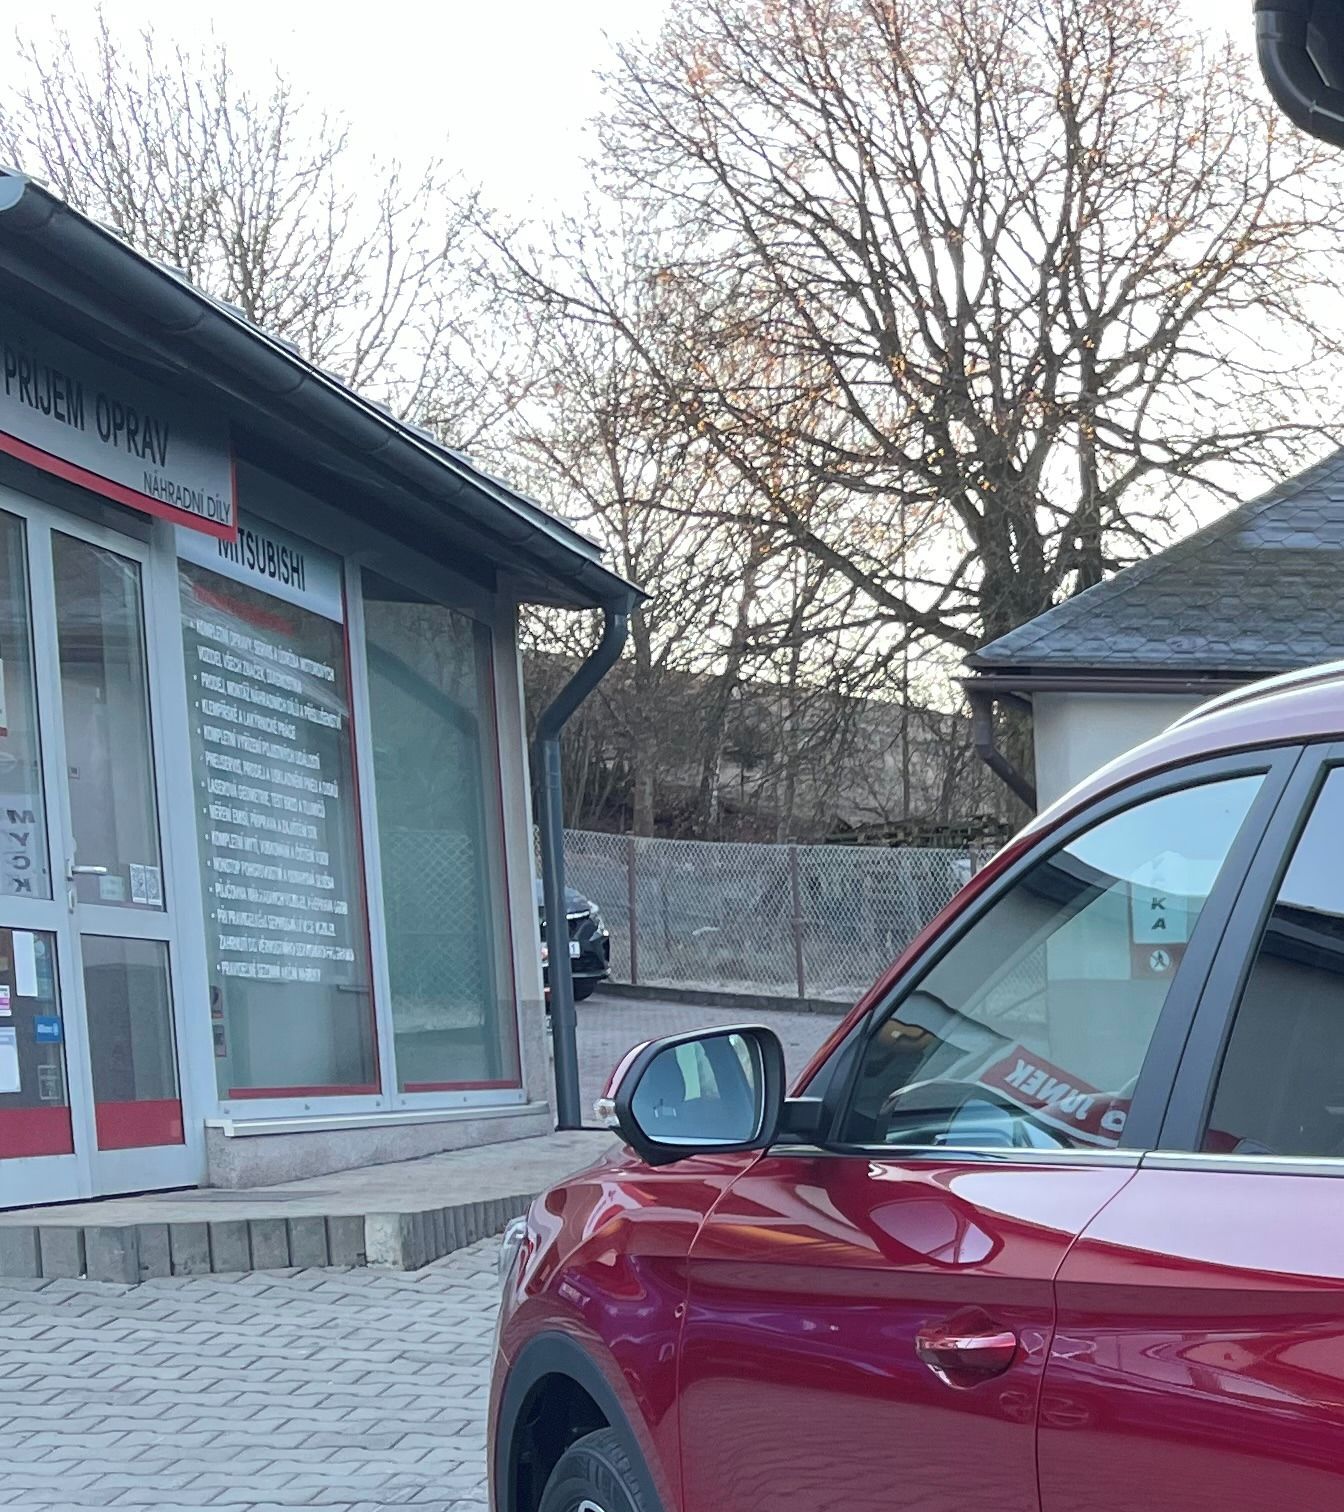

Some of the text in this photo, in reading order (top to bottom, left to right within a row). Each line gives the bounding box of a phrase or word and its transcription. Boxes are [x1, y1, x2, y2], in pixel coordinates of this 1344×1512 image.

[95, 391, 170, 468] OPRAV
[143, 470, 230, 523] NÁHRADNÍ DÍLY
[218, 529, 306, 592] MITSUBISHI
